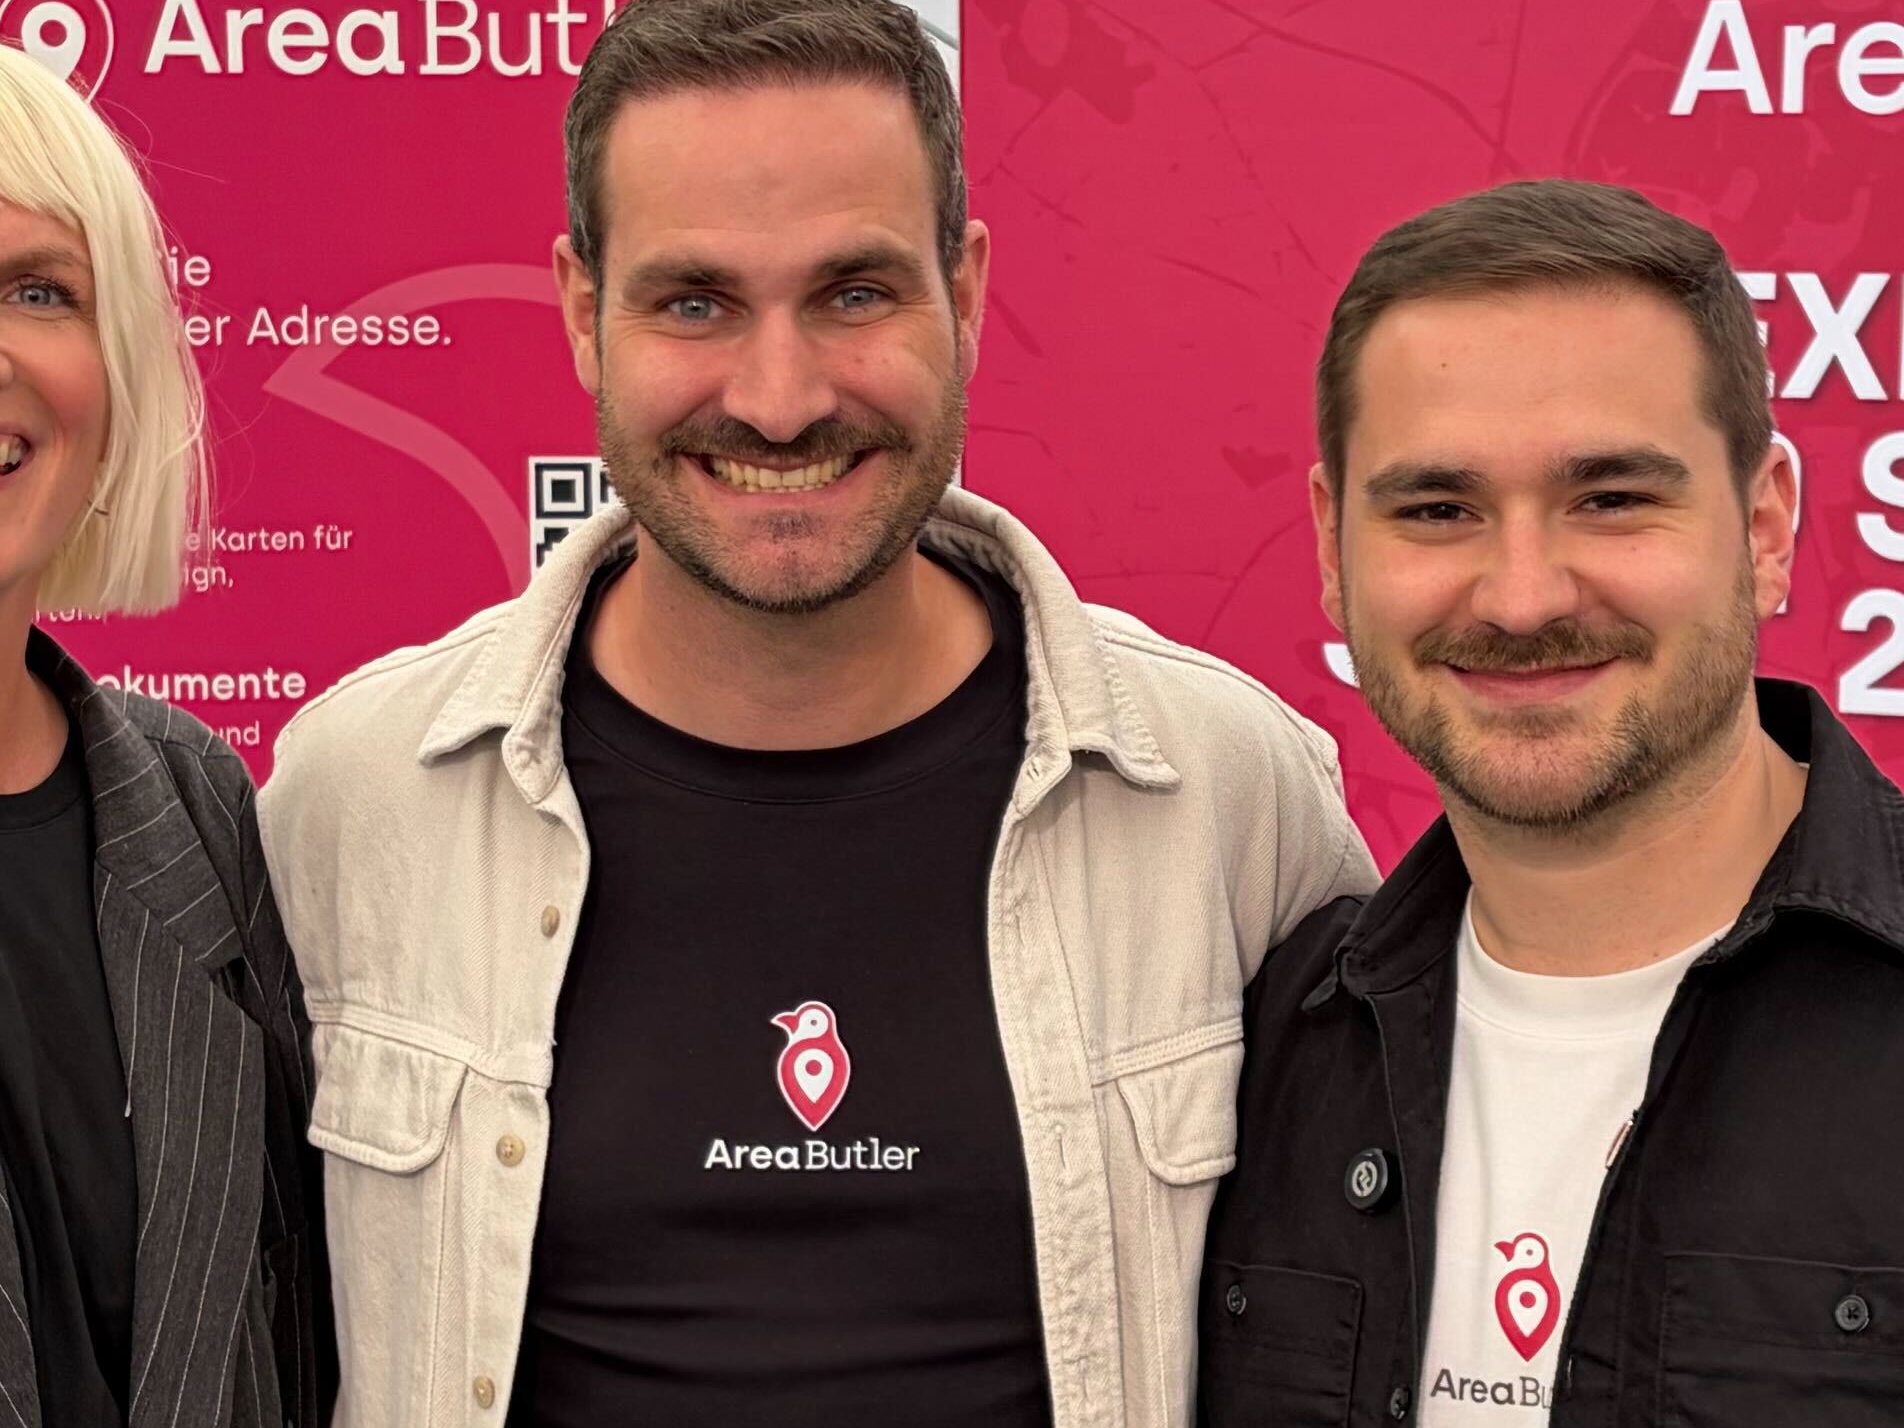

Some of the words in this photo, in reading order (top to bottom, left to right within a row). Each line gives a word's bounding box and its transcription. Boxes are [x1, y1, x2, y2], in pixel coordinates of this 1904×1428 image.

[247, 304, 452, 346] Adresse.
[212, 527, 306, 552] Karten
[314, 525, 353, 551] für
[704, 1137, 920, 1171] AreaButler
